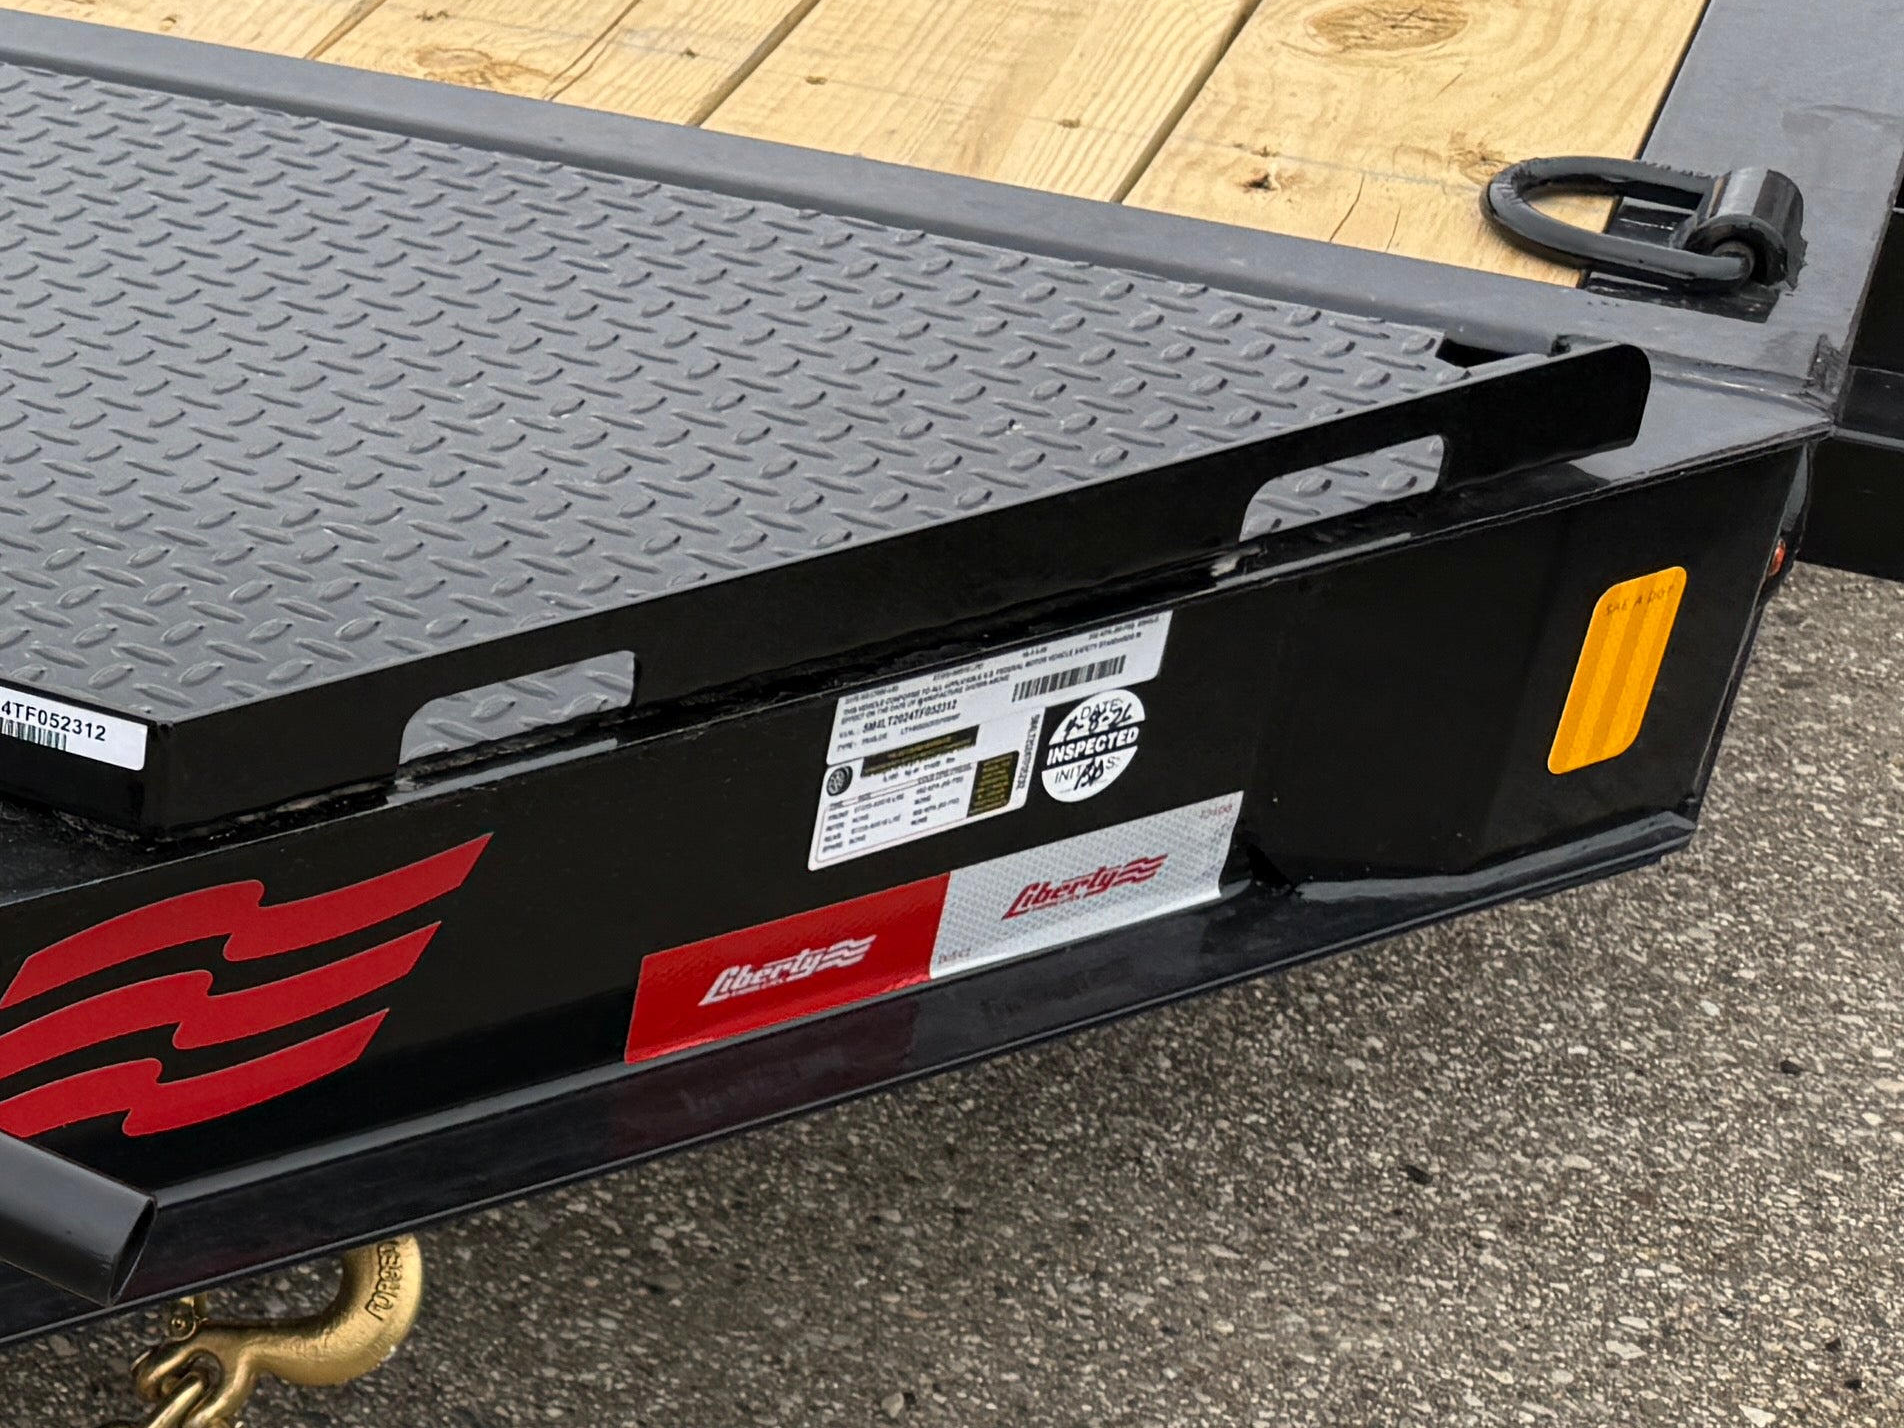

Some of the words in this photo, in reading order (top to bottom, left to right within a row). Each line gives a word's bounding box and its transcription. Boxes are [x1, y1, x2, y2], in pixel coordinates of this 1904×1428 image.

[1047, 726, 1139, 766] INSPECTED
[1001, 865, 1121, 921] Liberty
[698, 948, 828, 1007] Liberty
